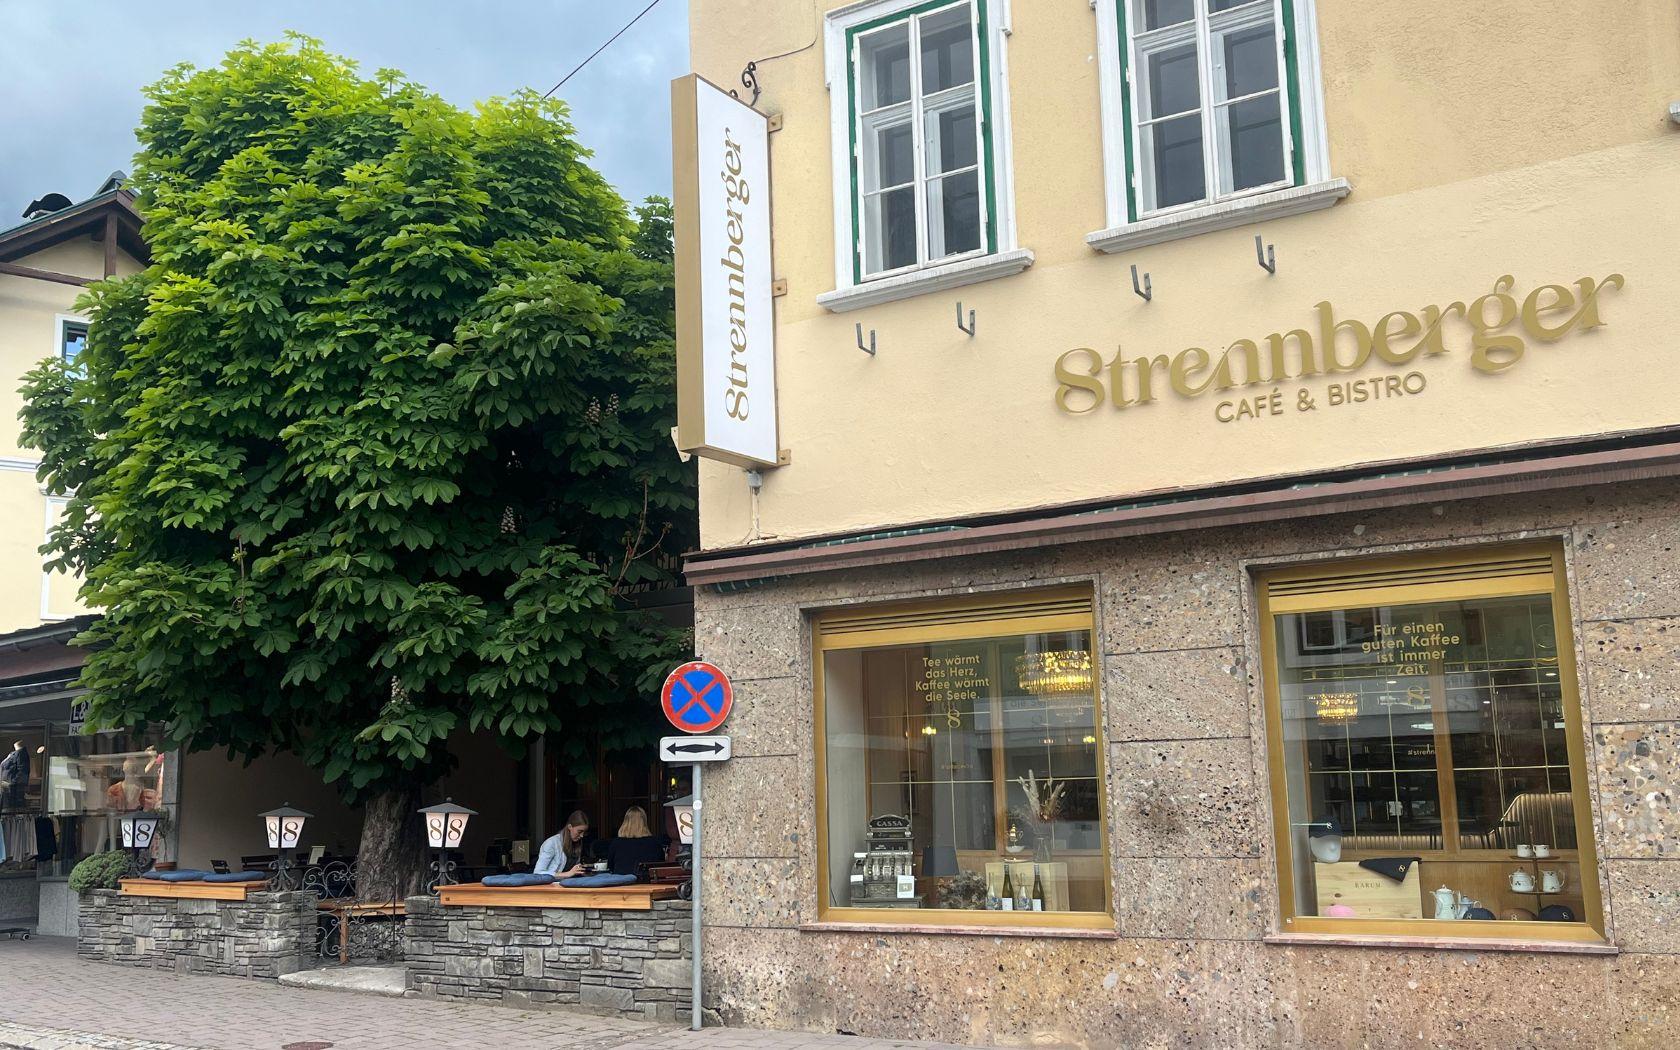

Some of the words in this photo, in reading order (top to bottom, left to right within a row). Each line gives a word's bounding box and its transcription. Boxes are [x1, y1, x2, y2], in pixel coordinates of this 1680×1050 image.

[721, 126, 749, 422] Strennberger
[1054, 273, 1625, 414] Strennberger
[1215, 387, 1283, 423] CAFÉ
[1296, 387, 1316, 412] &
[1327, 371, 1427, 407] BISTRO
[1374, 624, 1397, 637] Für
[1402, 622, 1445, 634] einen
[1361, 639, 1405, 654] guten
[1410, 633, 1460, 648] Kaffee
[922, 657, 941, 667] Tee
[945, 655, 980, 666] wärmt
[1376, 652, 1394, 664] ist
[1400, 650, 1446, 662] immer
[925, 669, 946, 679] das
[949, 667, 977, 677] Herz,
[1396, 663, 1429, 675] Zeit.
[915, 680, 950, 691] Kaffee
[954, 678, 990, 689] wärmt
[925, 691, 943, 702] die
[946, 689, 980, 701] Seele.
